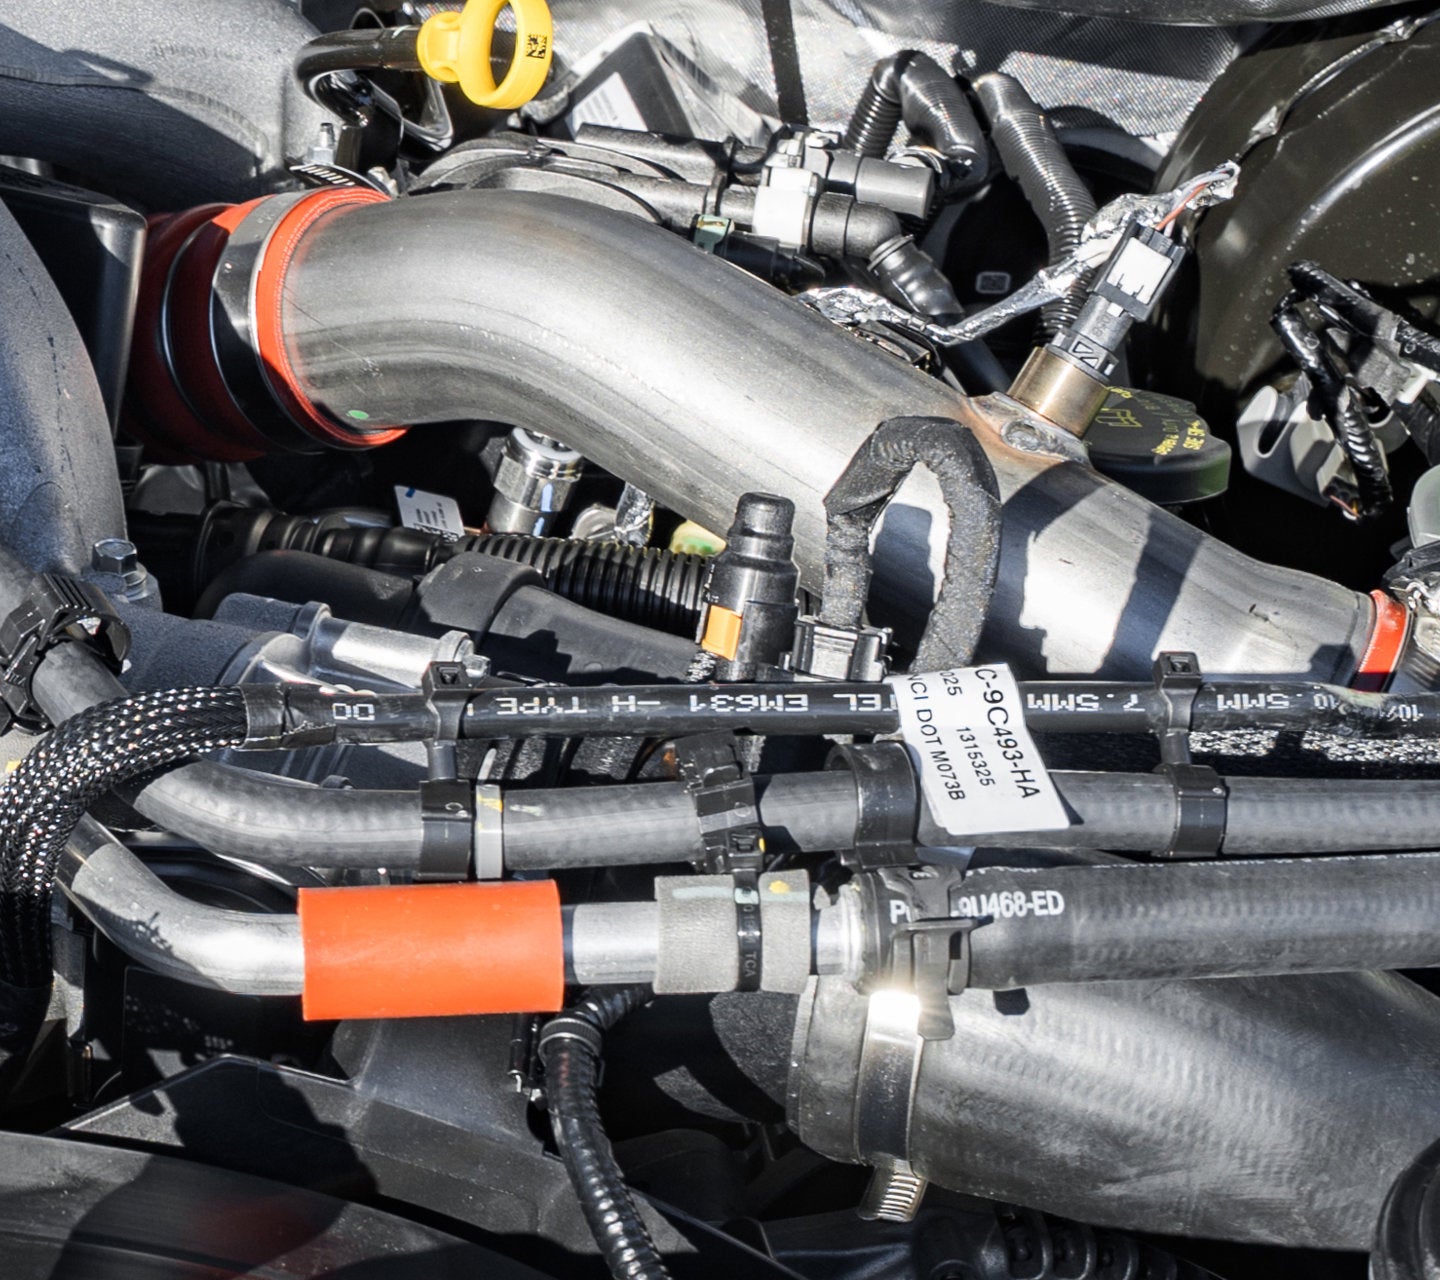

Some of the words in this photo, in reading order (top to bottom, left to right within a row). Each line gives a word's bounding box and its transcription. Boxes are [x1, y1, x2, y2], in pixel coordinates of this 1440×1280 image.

[496, 694, 589, 716] TYPE
[689, 693, 808, 715] EM631
[974, 668, 1041, 800] C-9C493-HA
[916, 708, 943, 747] DOT
[930, 750, 967, 802] M073B
[955, 726, 997, 788] 1315325
